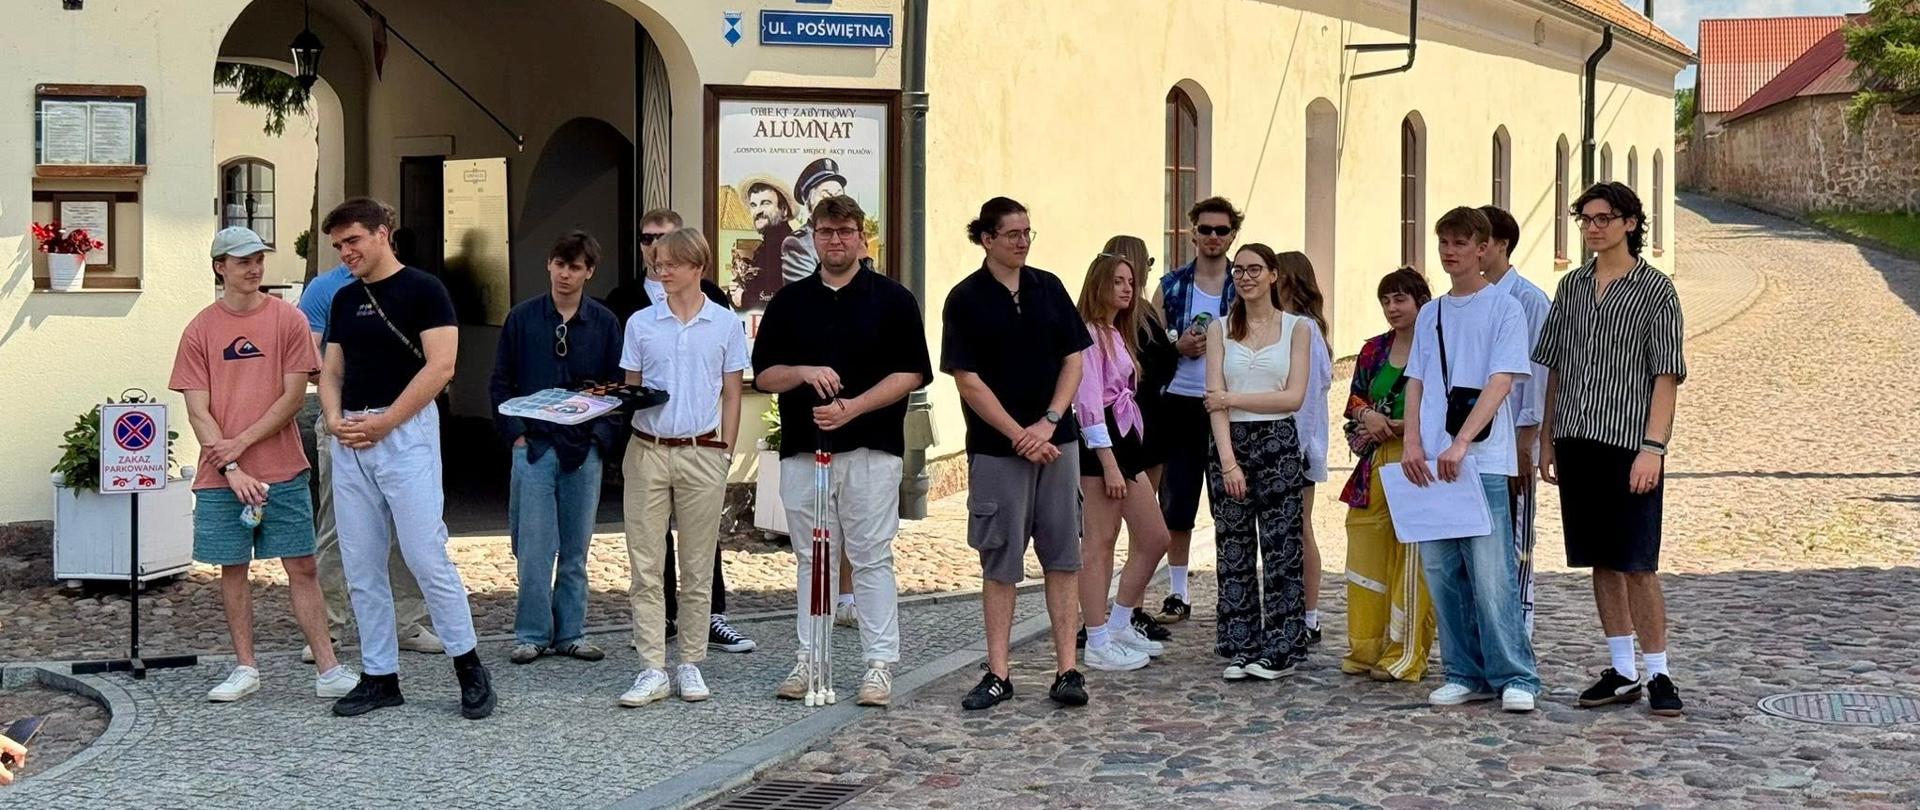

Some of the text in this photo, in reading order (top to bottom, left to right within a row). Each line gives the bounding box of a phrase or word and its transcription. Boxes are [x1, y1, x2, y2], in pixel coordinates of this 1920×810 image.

[768, 19, 885, 39] UL. POŚWIĘTNA
[750, 106, 857, 119] OBIEKT ZABYTKOWY
[753, 118, 854, 142] ALUMNAT
[118, 455, 151, 464] ZAKAZ
[104, 464, 164, 473] PARKOWANIA
